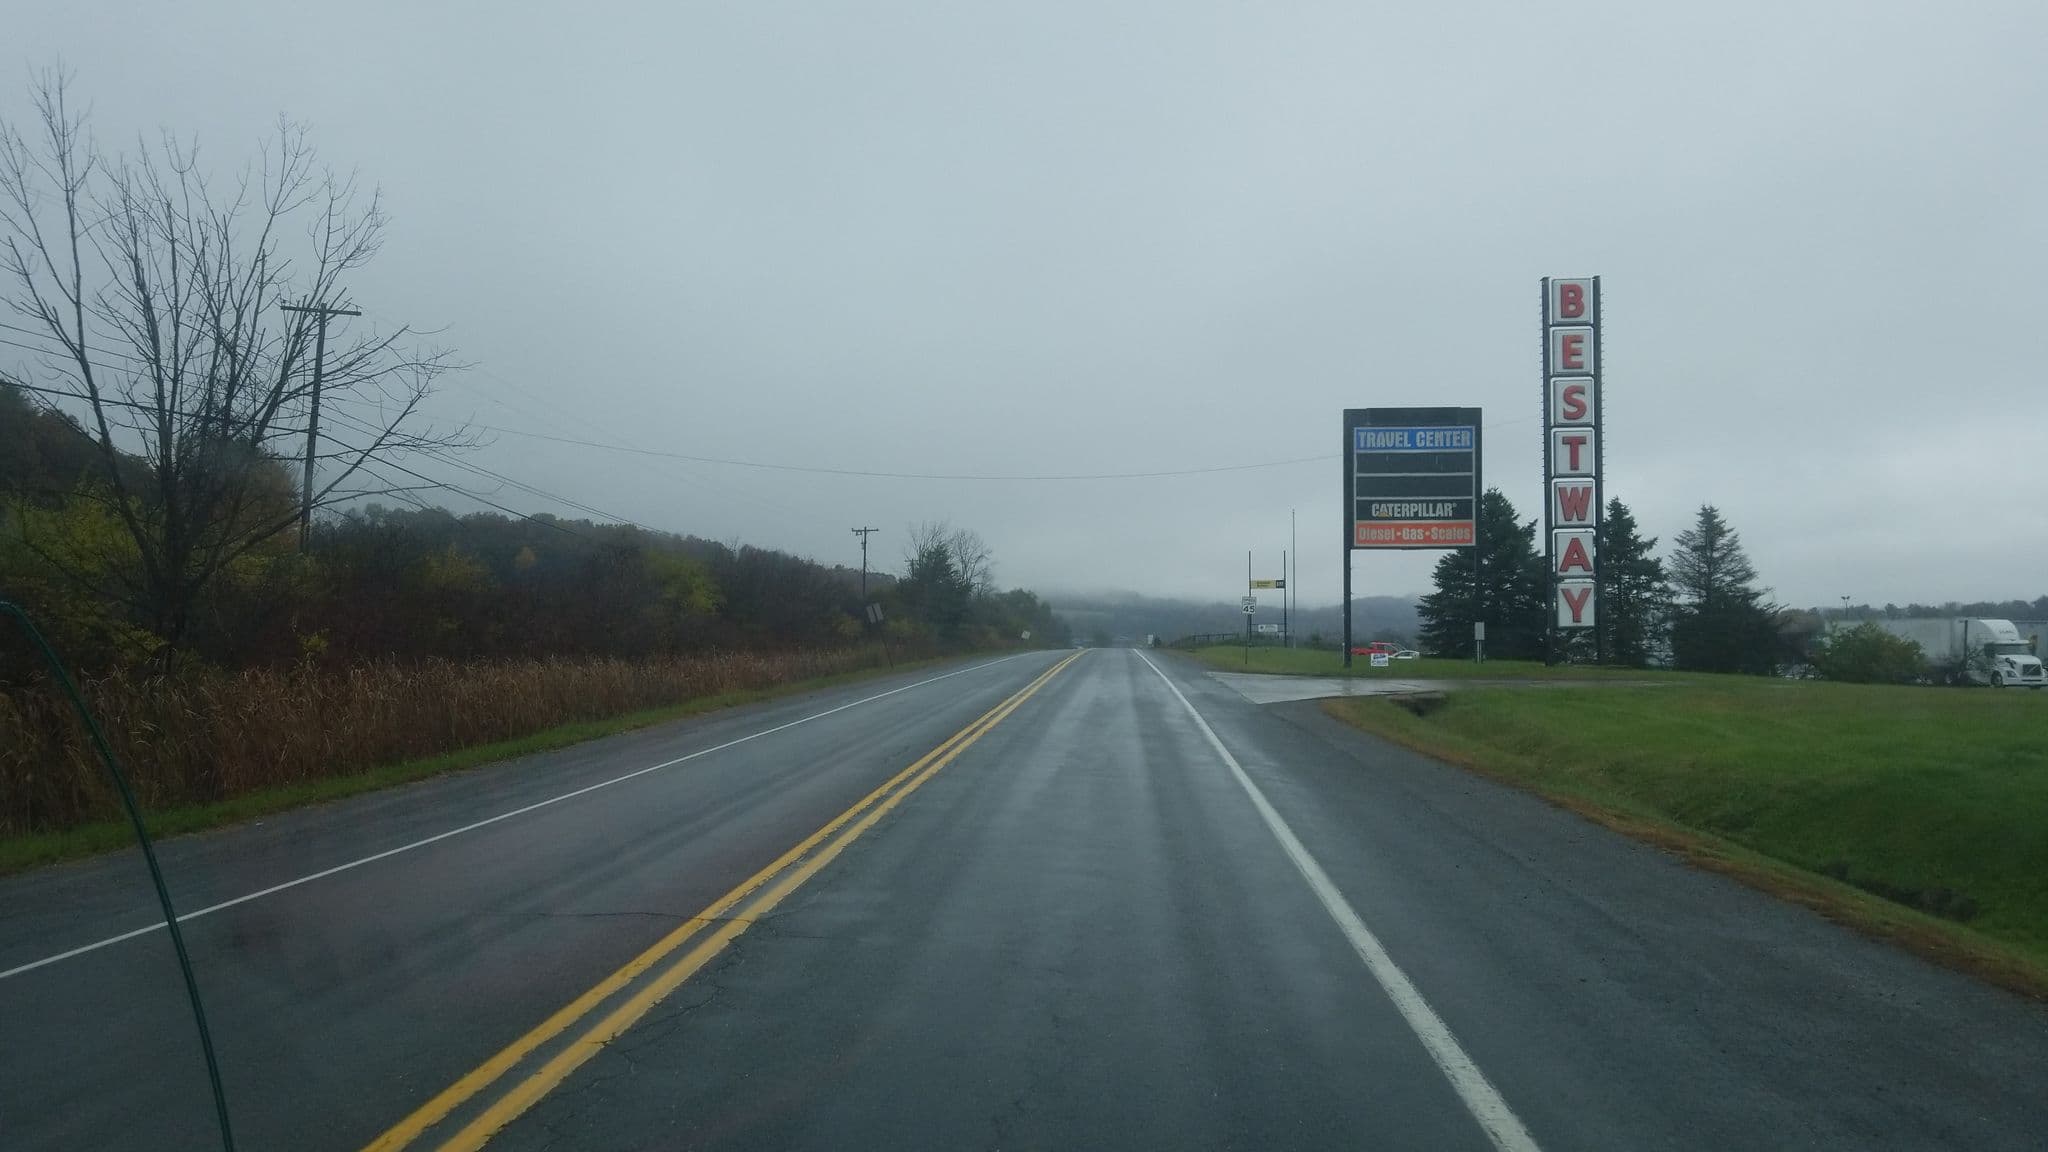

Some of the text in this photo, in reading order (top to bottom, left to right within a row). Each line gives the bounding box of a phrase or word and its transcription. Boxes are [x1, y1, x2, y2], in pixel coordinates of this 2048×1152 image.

[1358, 430, 1471, 449] TRAVEL CENTER
[1557, 283, 1593, 624] BESTWAY
[1243, 605, 1255, 613] 45
